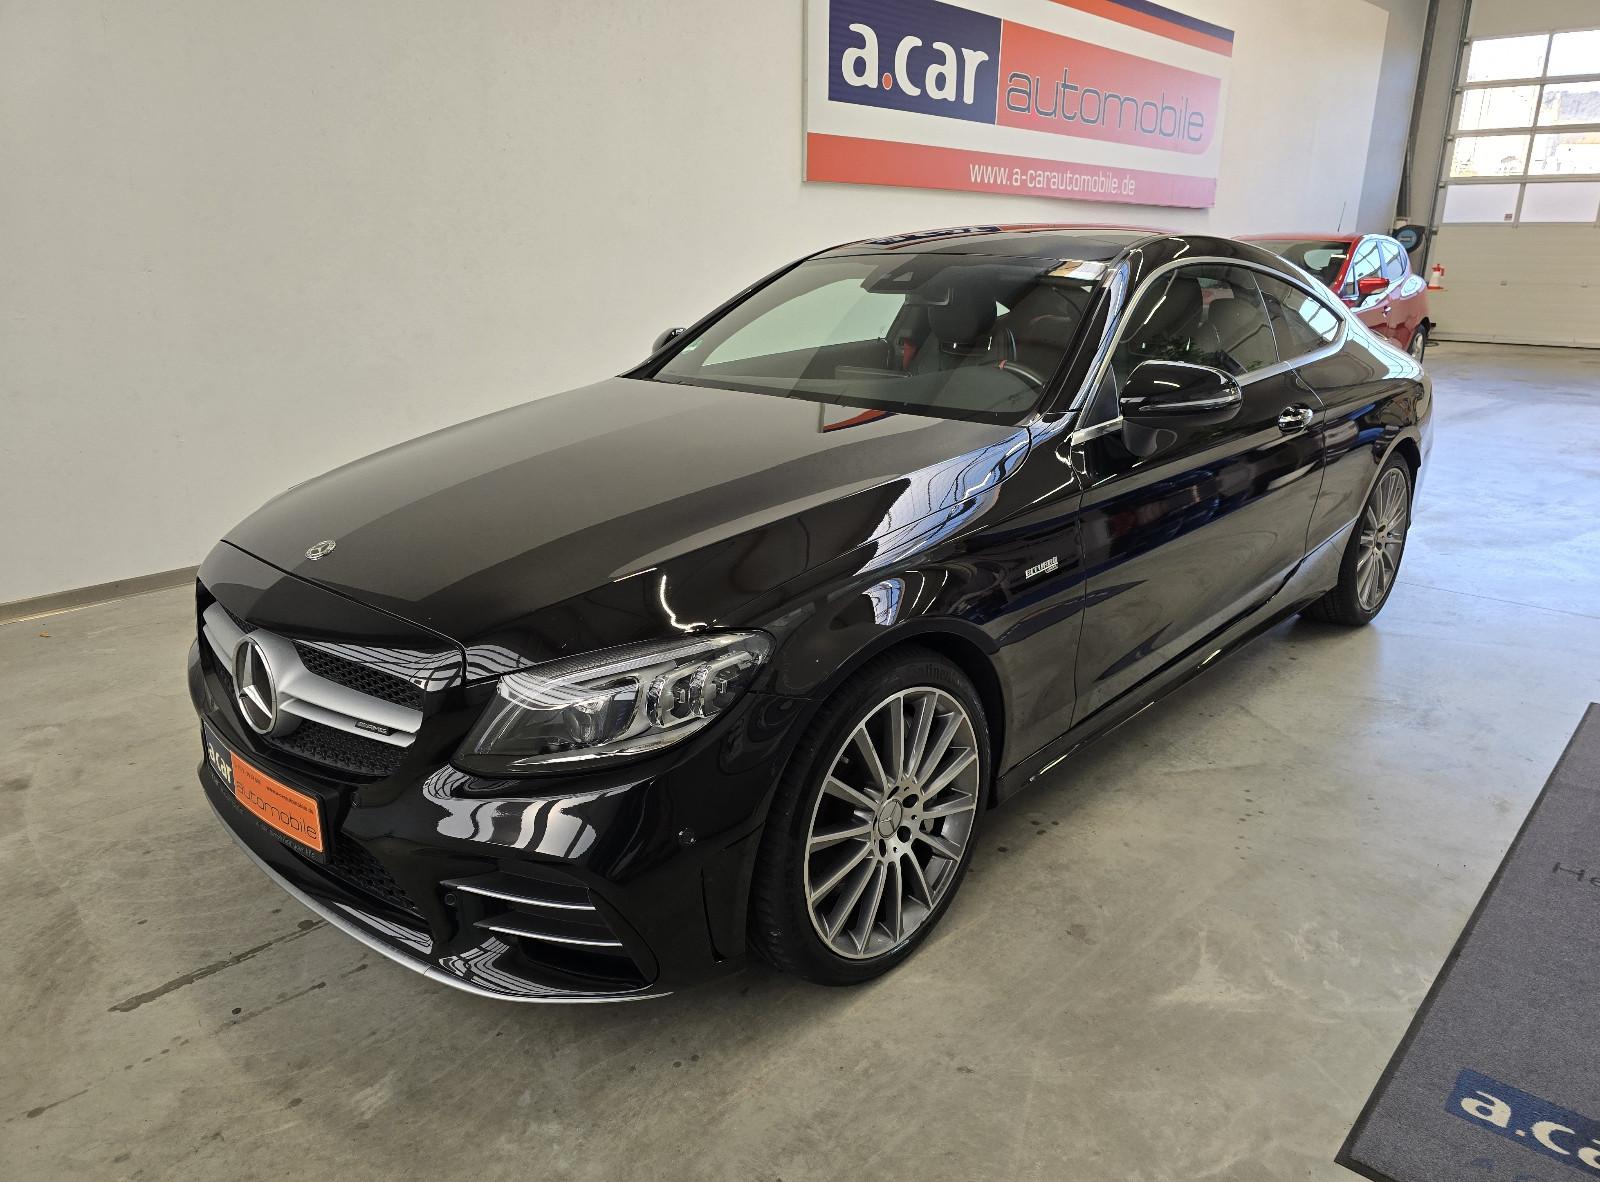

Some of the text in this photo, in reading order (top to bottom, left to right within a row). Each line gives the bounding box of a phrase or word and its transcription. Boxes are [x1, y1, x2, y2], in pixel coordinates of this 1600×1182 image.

[841, 23, 1204, 142] a.car automobile
[969, 163, 1136, 196] www.a-carautomobile.de
[236, 781, 317, 840] automobile
